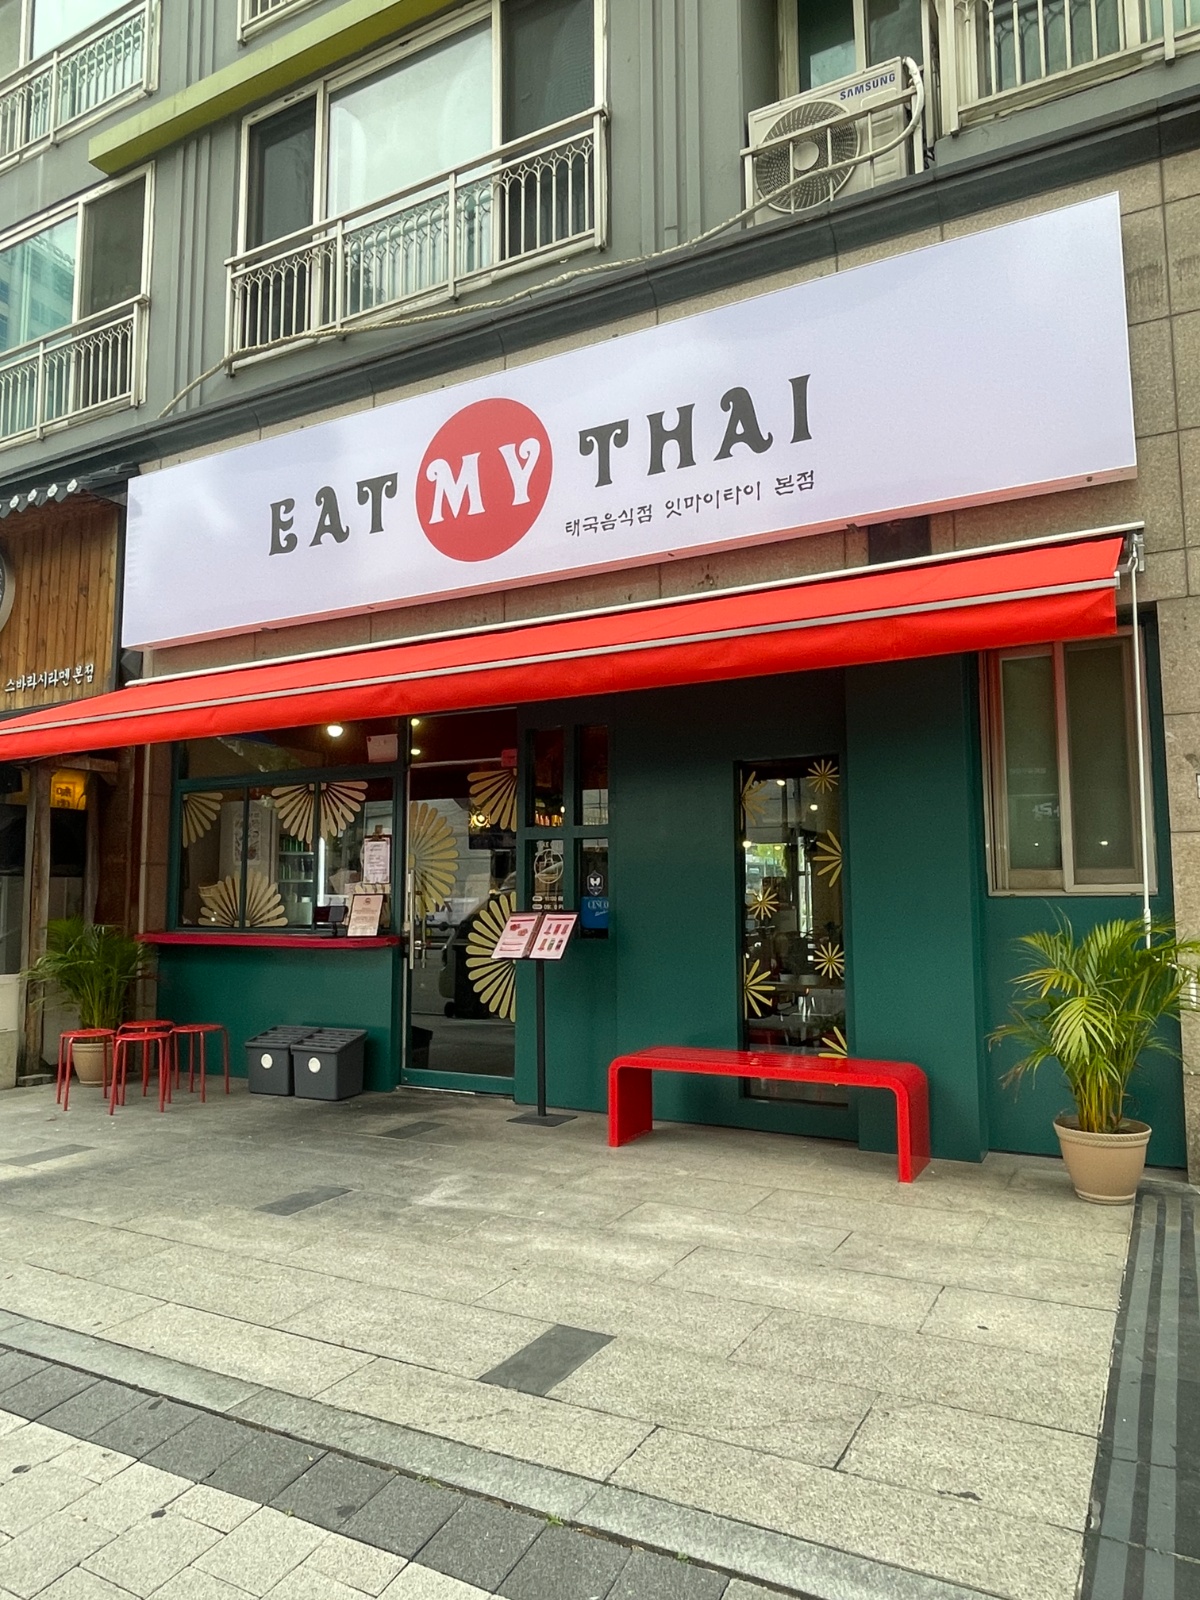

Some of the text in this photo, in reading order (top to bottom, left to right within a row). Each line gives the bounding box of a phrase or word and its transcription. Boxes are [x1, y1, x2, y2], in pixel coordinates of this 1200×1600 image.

[840, 73, 896, 100] SAMSUNG
[269, 374, 812, 556] EAT MY THAI
[565, 469, 815, 537] 태국음식점 잇마이타이 본점
[4, 663, 94, 693] 스바라시라멘 본점
